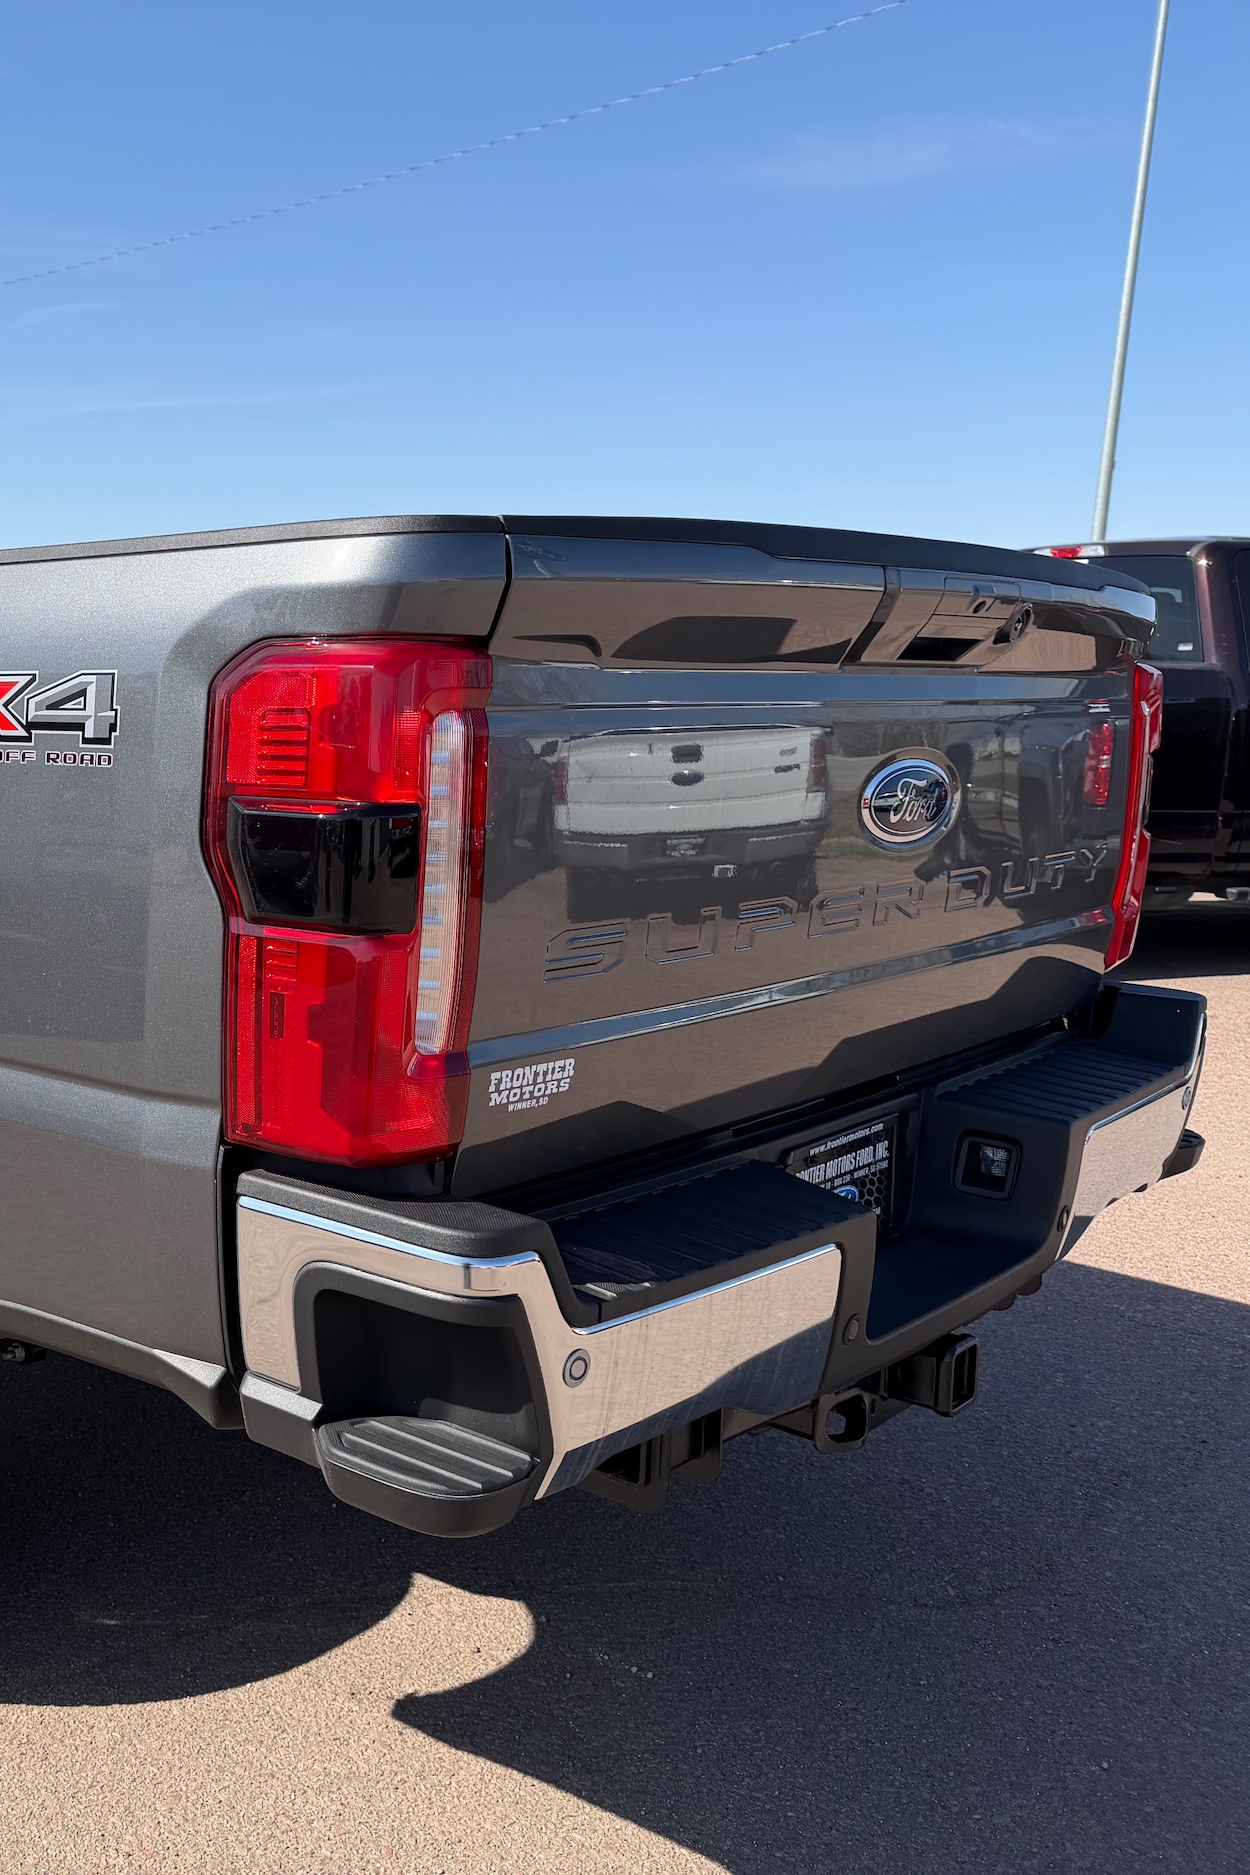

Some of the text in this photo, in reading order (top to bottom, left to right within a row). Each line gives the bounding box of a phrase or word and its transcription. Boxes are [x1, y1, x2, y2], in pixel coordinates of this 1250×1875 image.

[45, 750, 114, 767] ROAD
[890, 777, 938, 824] Ford
[543, 842, 1108, 983] SUPER DUTY
[488, 1058, 576, 1093] FRONTIER
[489, 1077, 571, 1107] MOTORS
[825, 1152, 856, 1180] MOTORS
